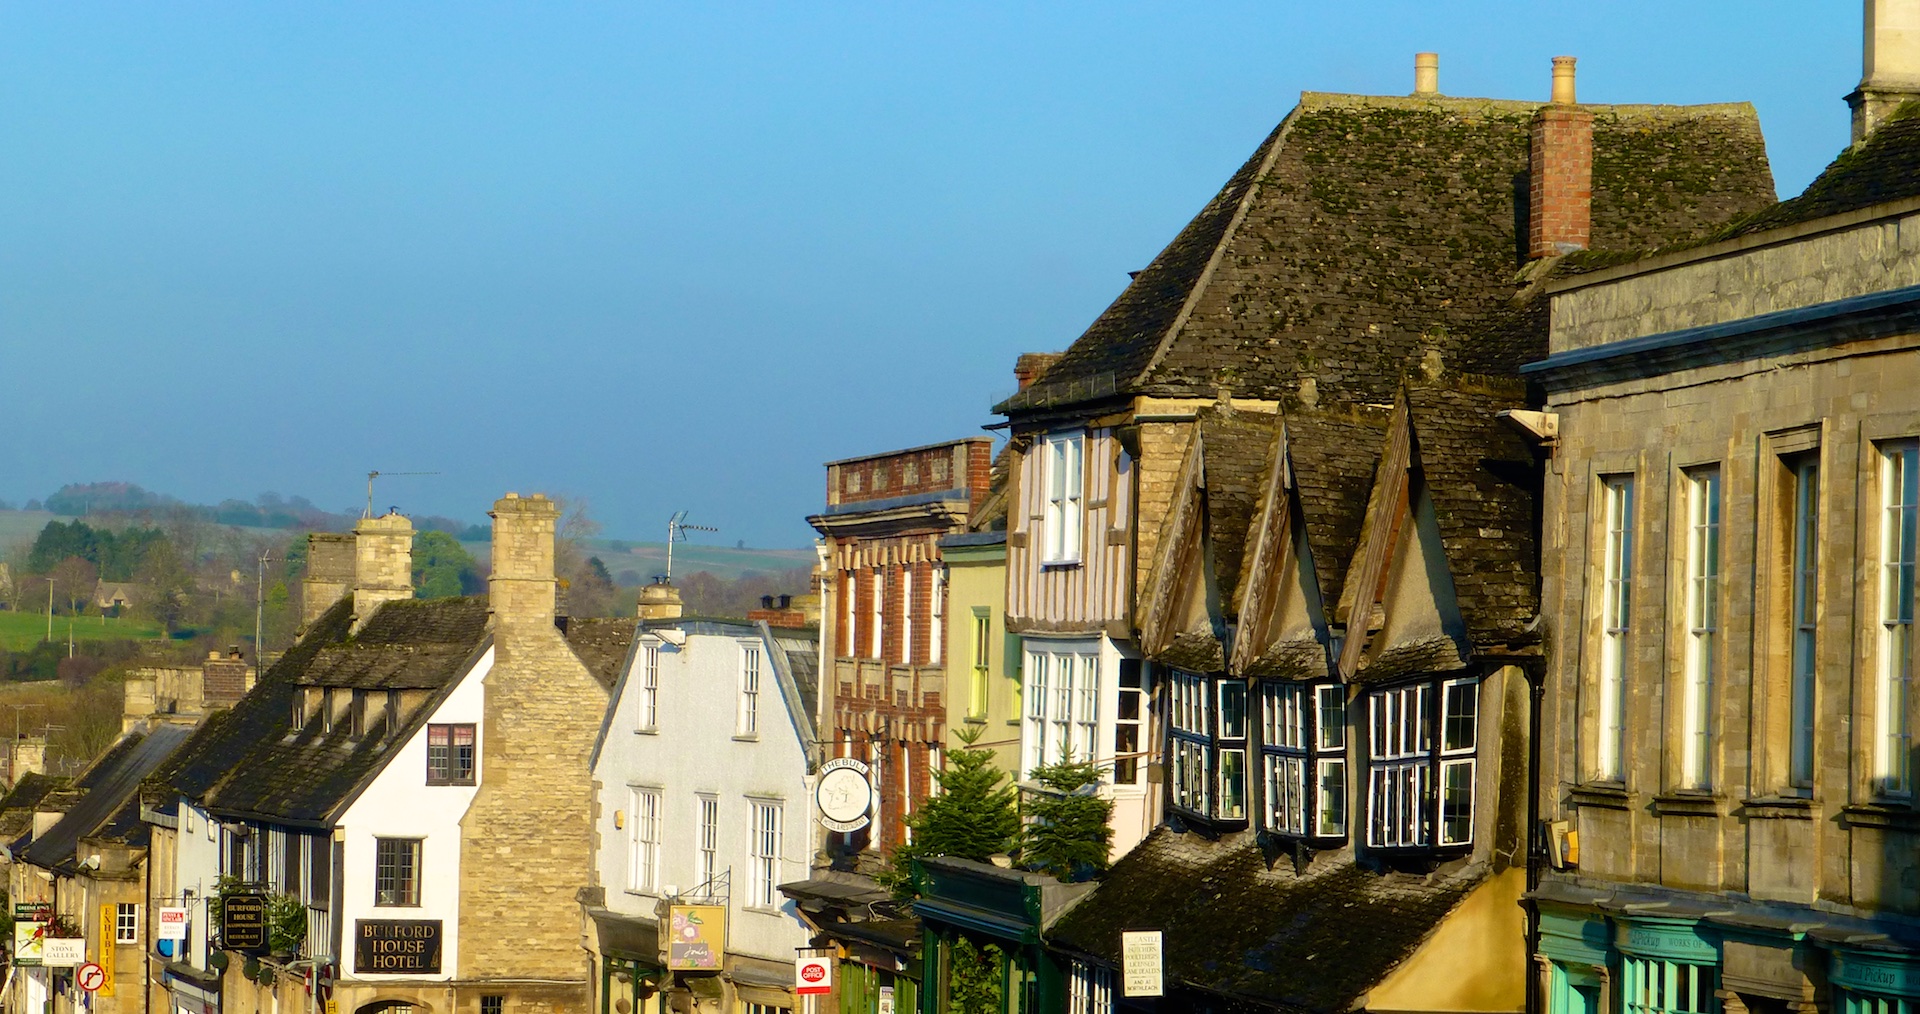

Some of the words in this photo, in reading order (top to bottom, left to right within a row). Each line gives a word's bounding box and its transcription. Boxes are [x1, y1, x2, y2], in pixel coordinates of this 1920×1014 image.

[822, 760, 841, 773] THE
[841, 759, 866, 773] BULL
[364, 925, 435, 938] BURFORD
[372, 940, 425, 953] HOUSE
[1669, 938, 1691, 948] WORKS
[1693, 940, 1703, 949] OF
[373, 955, 424, 968] HOTEL
[1865, 967, 1895, 987] Pickup
